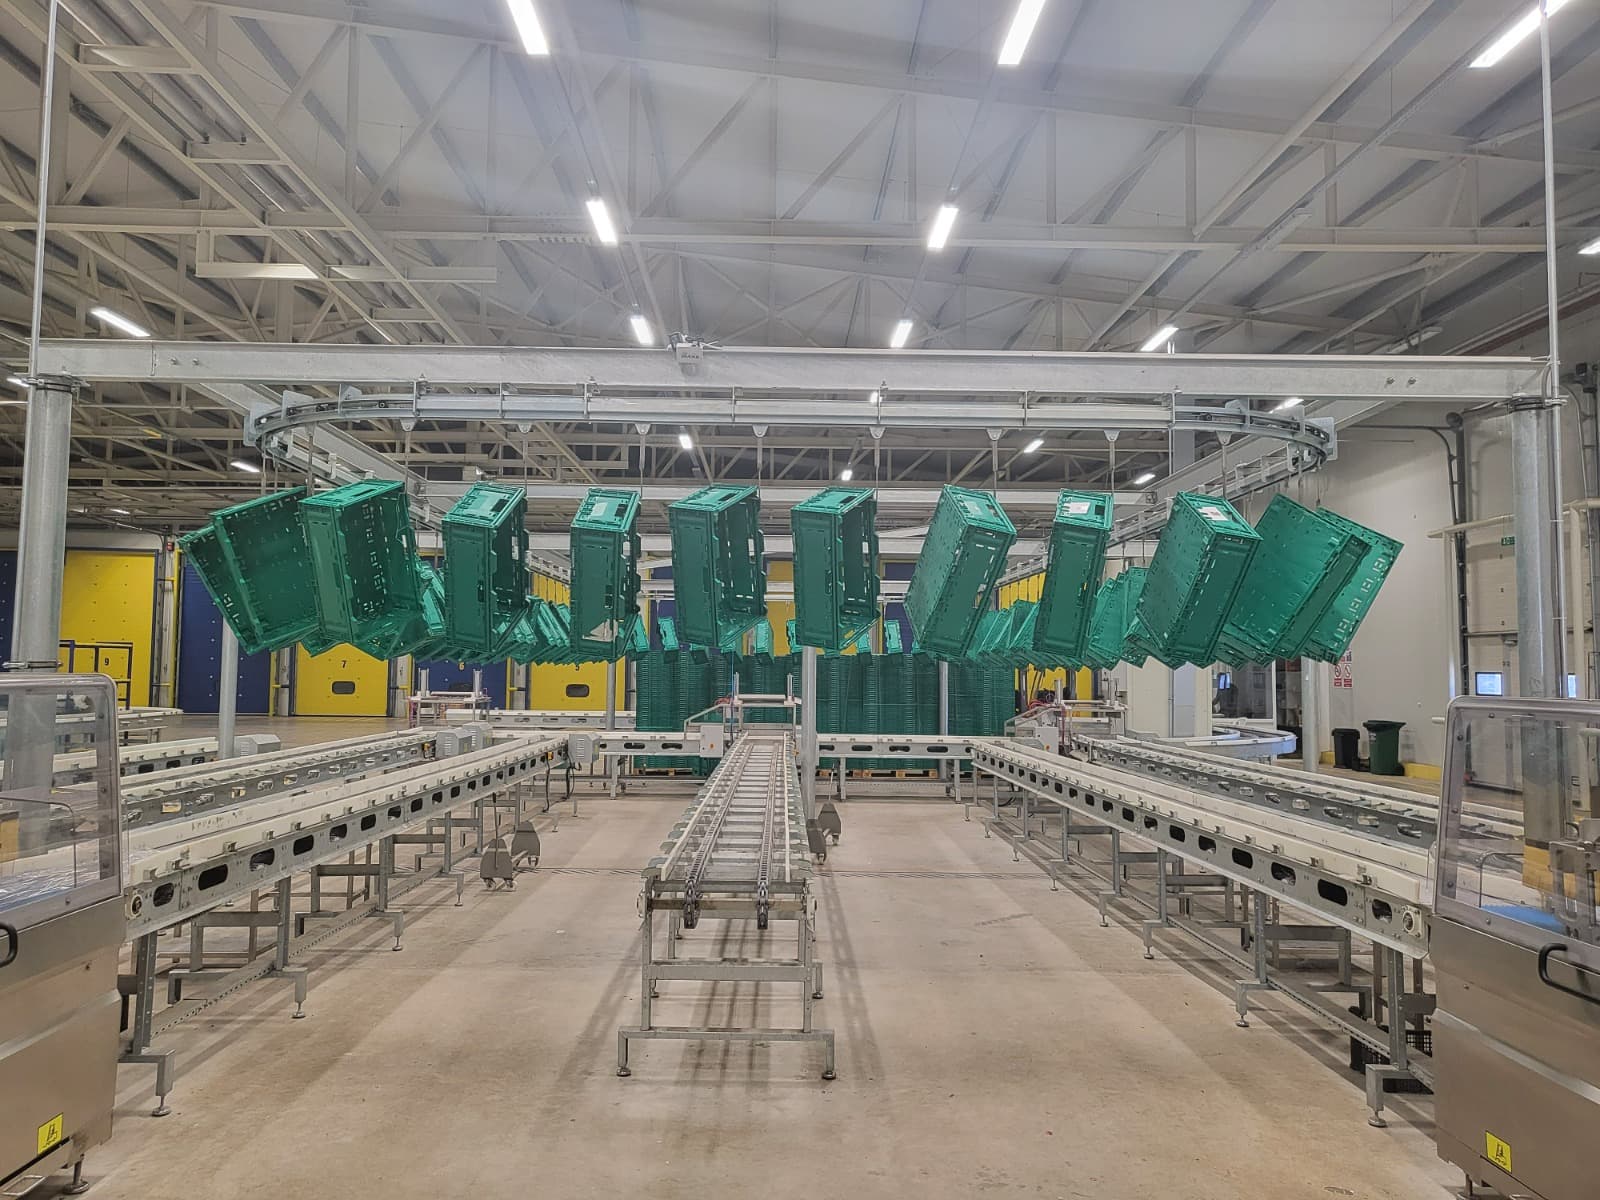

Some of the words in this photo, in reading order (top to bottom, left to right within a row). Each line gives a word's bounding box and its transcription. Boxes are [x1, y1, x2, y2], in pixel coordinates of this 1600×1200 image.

[104, 657, 110, 666] 9
[341, 659, 347, 669] 7
[458, 661, 465, 671] 6
